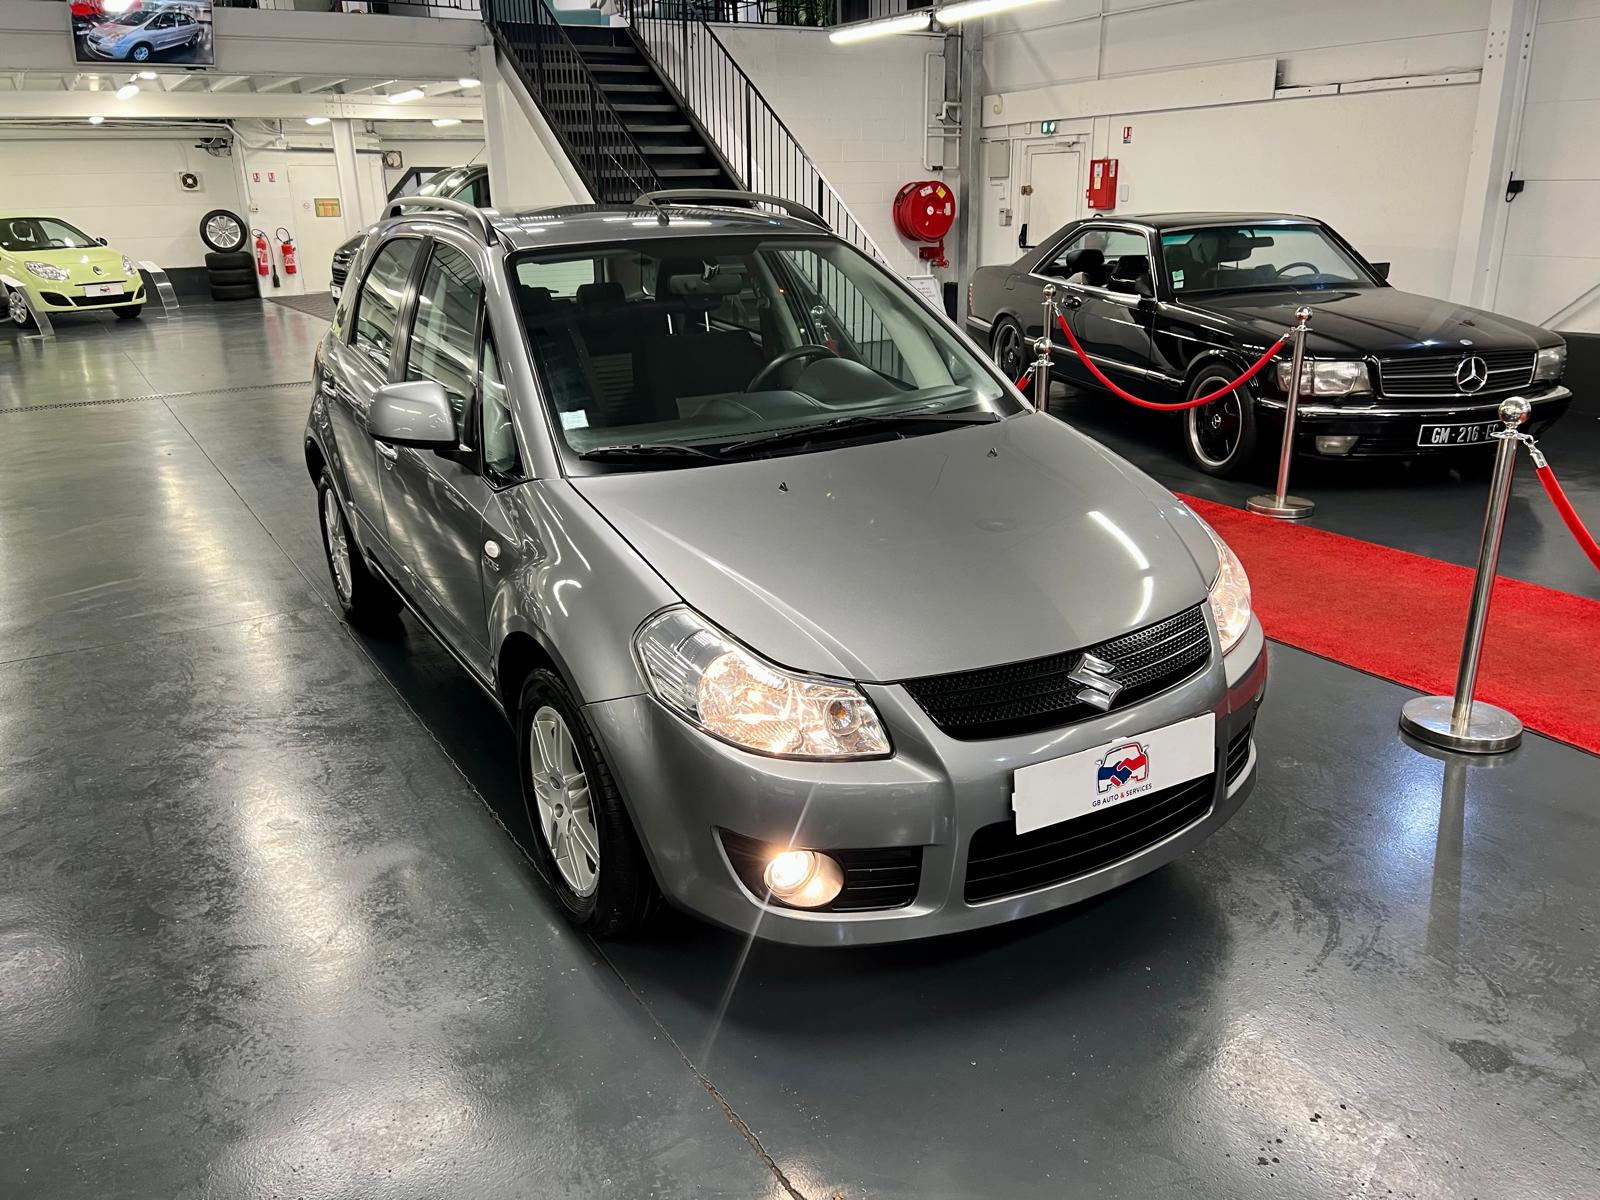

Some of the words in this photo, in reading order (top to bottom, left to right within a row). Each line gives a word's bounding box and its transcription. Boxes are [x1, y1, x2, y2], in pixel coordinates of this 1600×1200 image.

[1092, 799, 1101, 807] GB
[1102, 794, 1119, 804] AUTO
[1126, 783, 1152, 797] SERVICES
